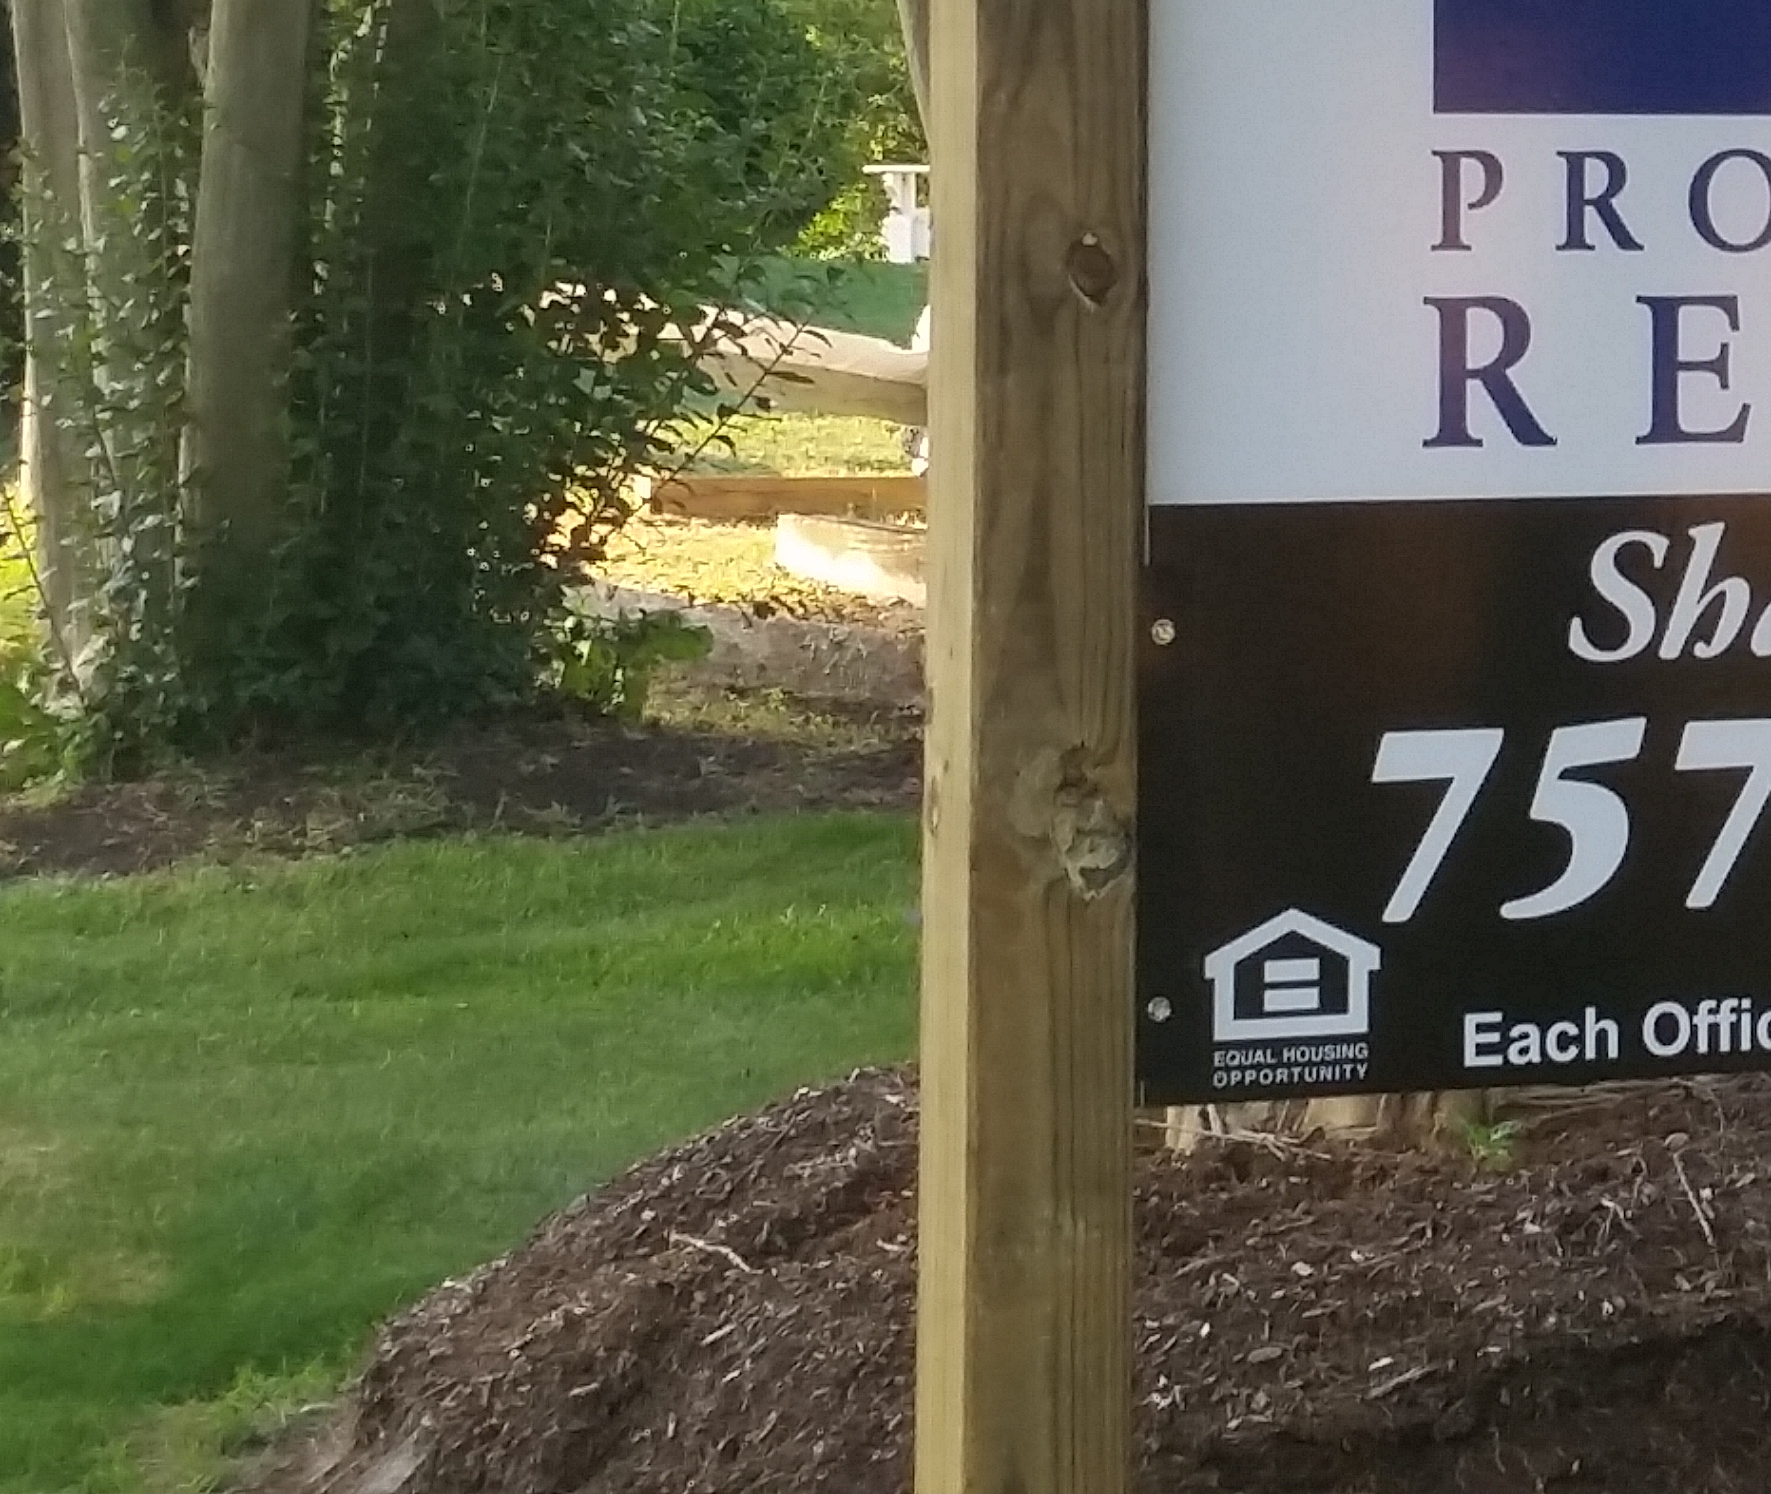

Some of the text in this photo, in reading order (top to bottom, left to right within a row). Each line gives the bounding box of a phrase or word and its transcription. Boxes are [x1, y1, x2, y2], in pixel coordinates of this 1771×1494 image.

[1463, 1006, 1619, 1068] Each
[1213, 1042, 1369, 1068] EQUAL HOUSING
[1212, 1061, 1368, 1089] OPPORTUNITY
